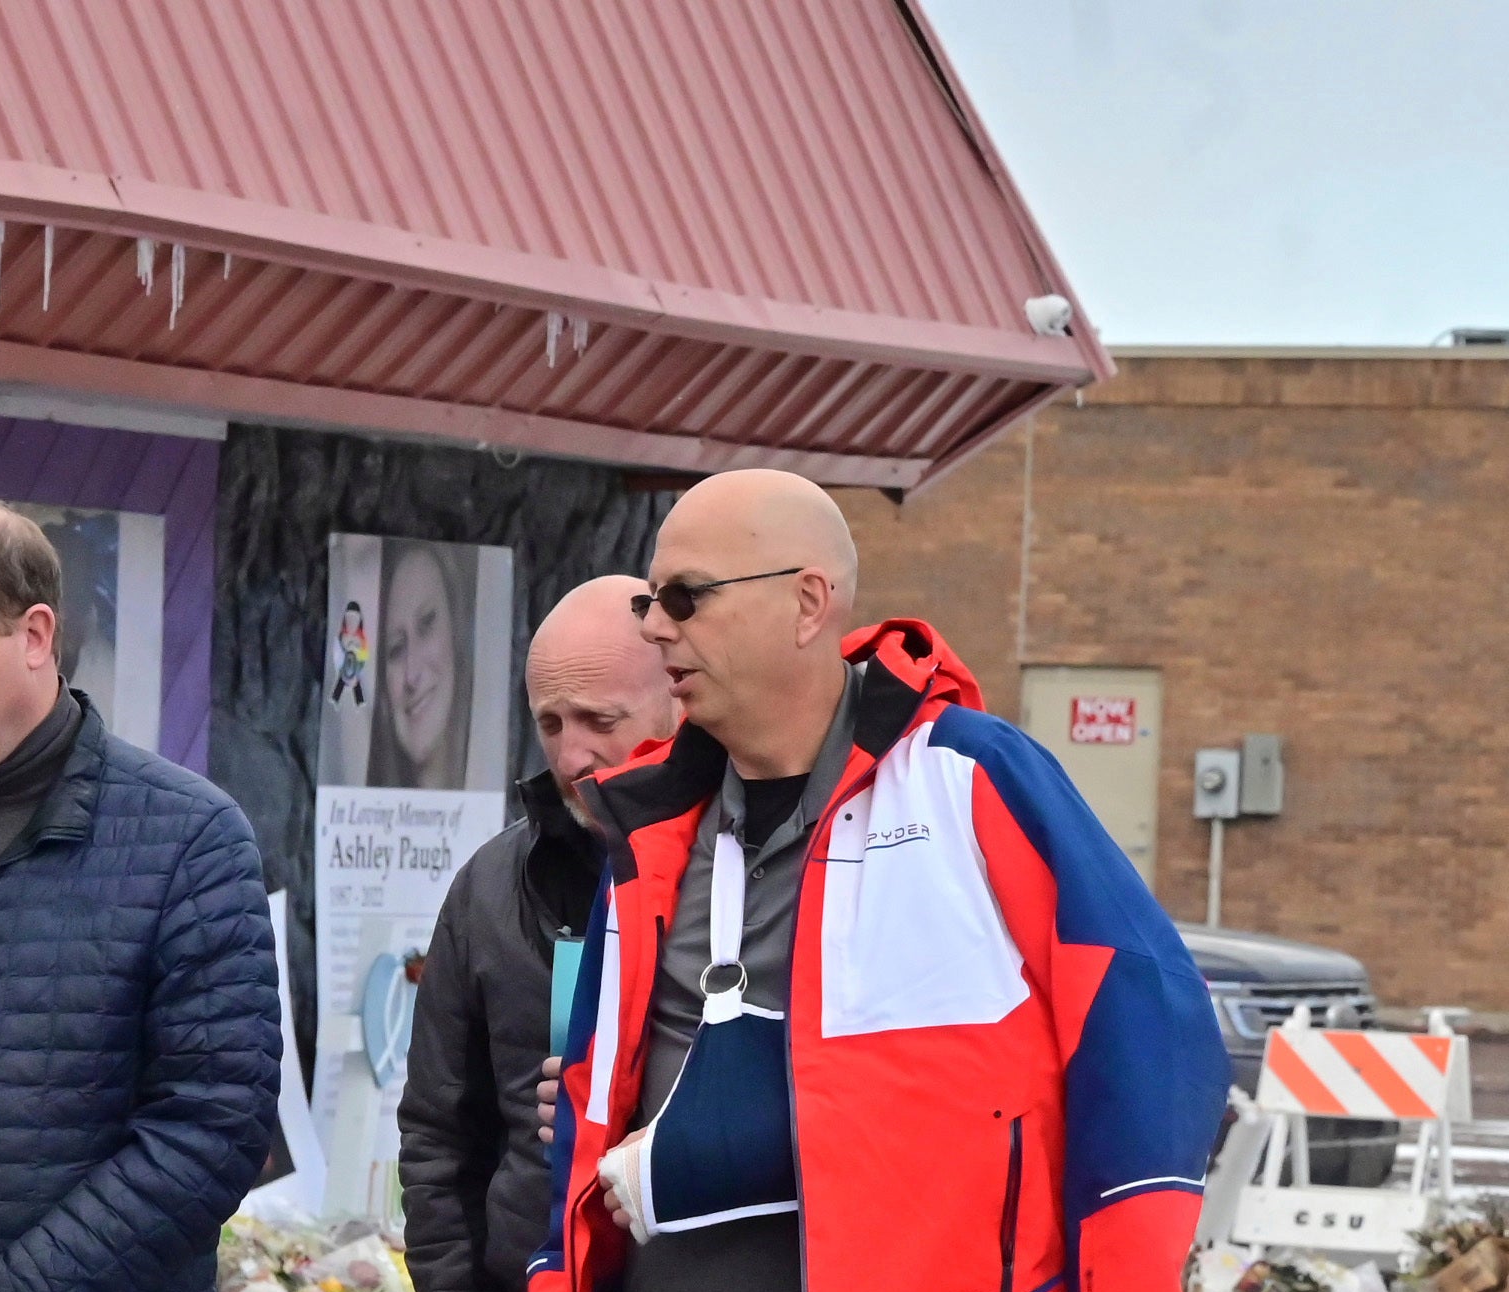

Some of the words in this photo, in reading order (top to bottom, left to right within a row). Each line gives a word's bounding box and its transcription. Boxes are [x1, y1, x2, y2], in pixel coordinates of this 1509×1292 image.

[1077, 699, 1132, 717] NOW
[1072, 723, 1132, 743] OPEN
[331, 800, 345, 825] In
[348, 801, 394, 834] Loving
[396, 802, 446, 834] Memory
[449, 801, 465, 836] of
[867, 823, 930, 845] PYDER
[330, 834, 393, 880] Ashley
[399, 836, 452, 882] Paugh
[1294, 1210, 1364, 1229] CSU
